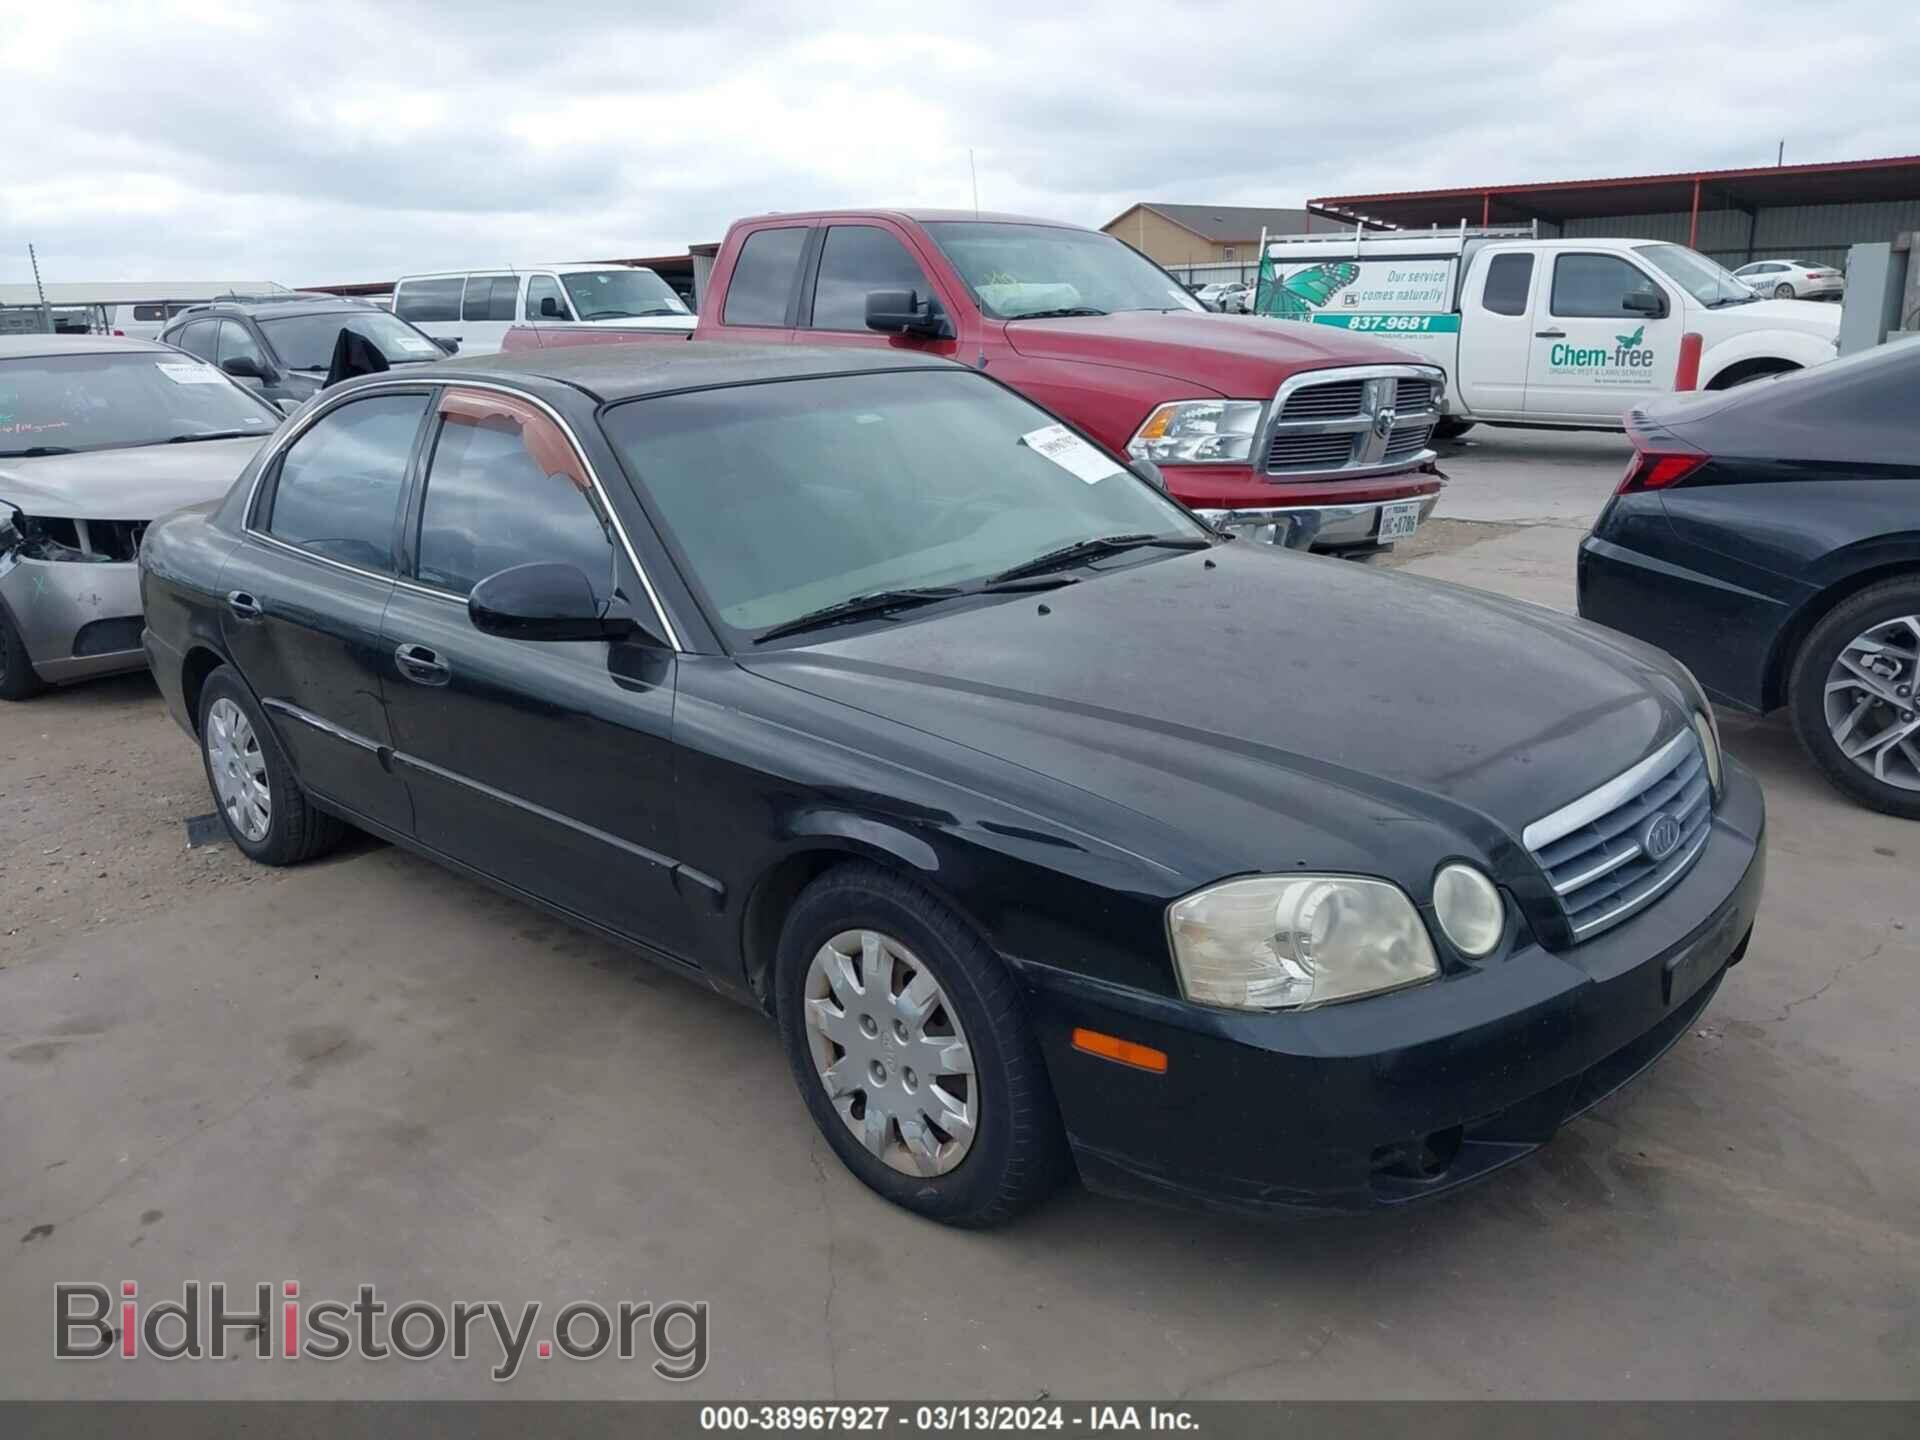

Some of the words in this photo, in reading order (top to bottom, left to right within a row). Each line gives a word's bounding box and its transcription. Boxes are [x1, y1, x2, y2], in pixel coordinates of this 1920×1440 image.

[1387, 270, 1407, 282] Our
[1408, 271, 1446, 282] service
[1362, 290, 1393, 301] comes
[1395, 288, 1443, 303] naturally
[1348, 316, 1432, 330] 837-9681
[1551, 343, 1654, 367] Chem-free
